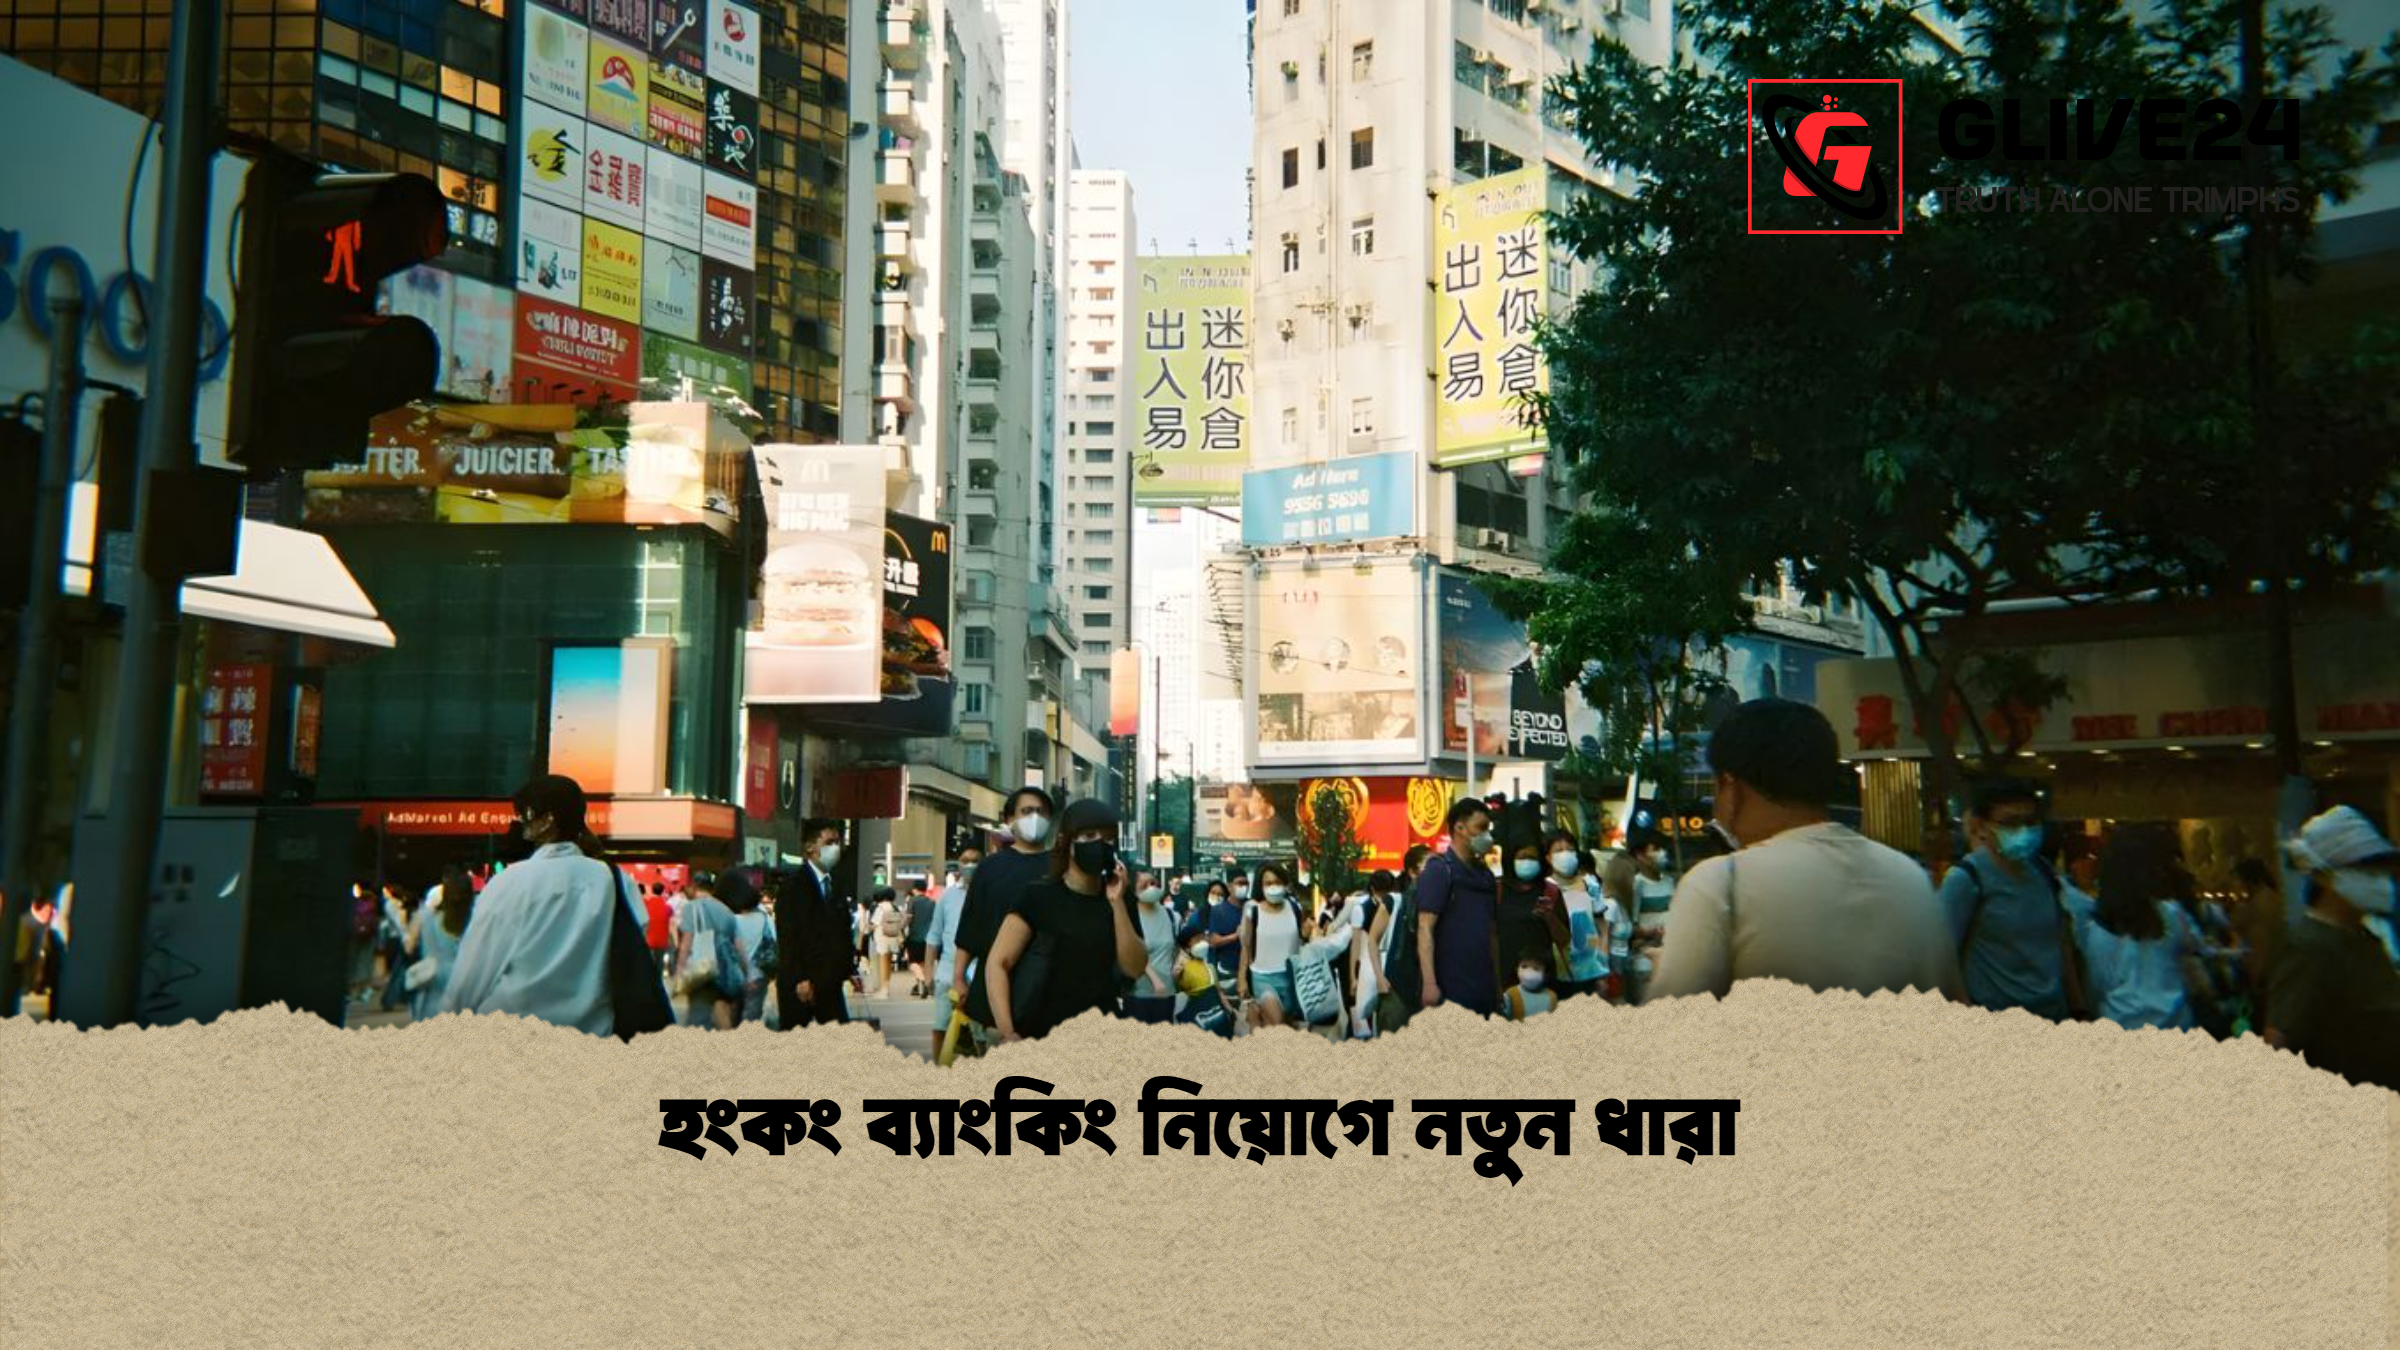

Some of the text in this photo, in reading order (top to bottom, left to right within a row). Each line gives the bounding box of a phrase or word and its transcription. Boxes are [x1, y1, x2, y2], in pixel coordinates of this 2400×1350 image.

[1443, 243, 1484, 401] 出入易
[1143, 308, 1187, 450] 出入易
[1200, 306, 1246, 450] 迷你倉
[1509, 726, 1568, 747] EPECTED
[1513, 708, 1563, 730] BEYOND
[457, 811, 476, 824] Ad
